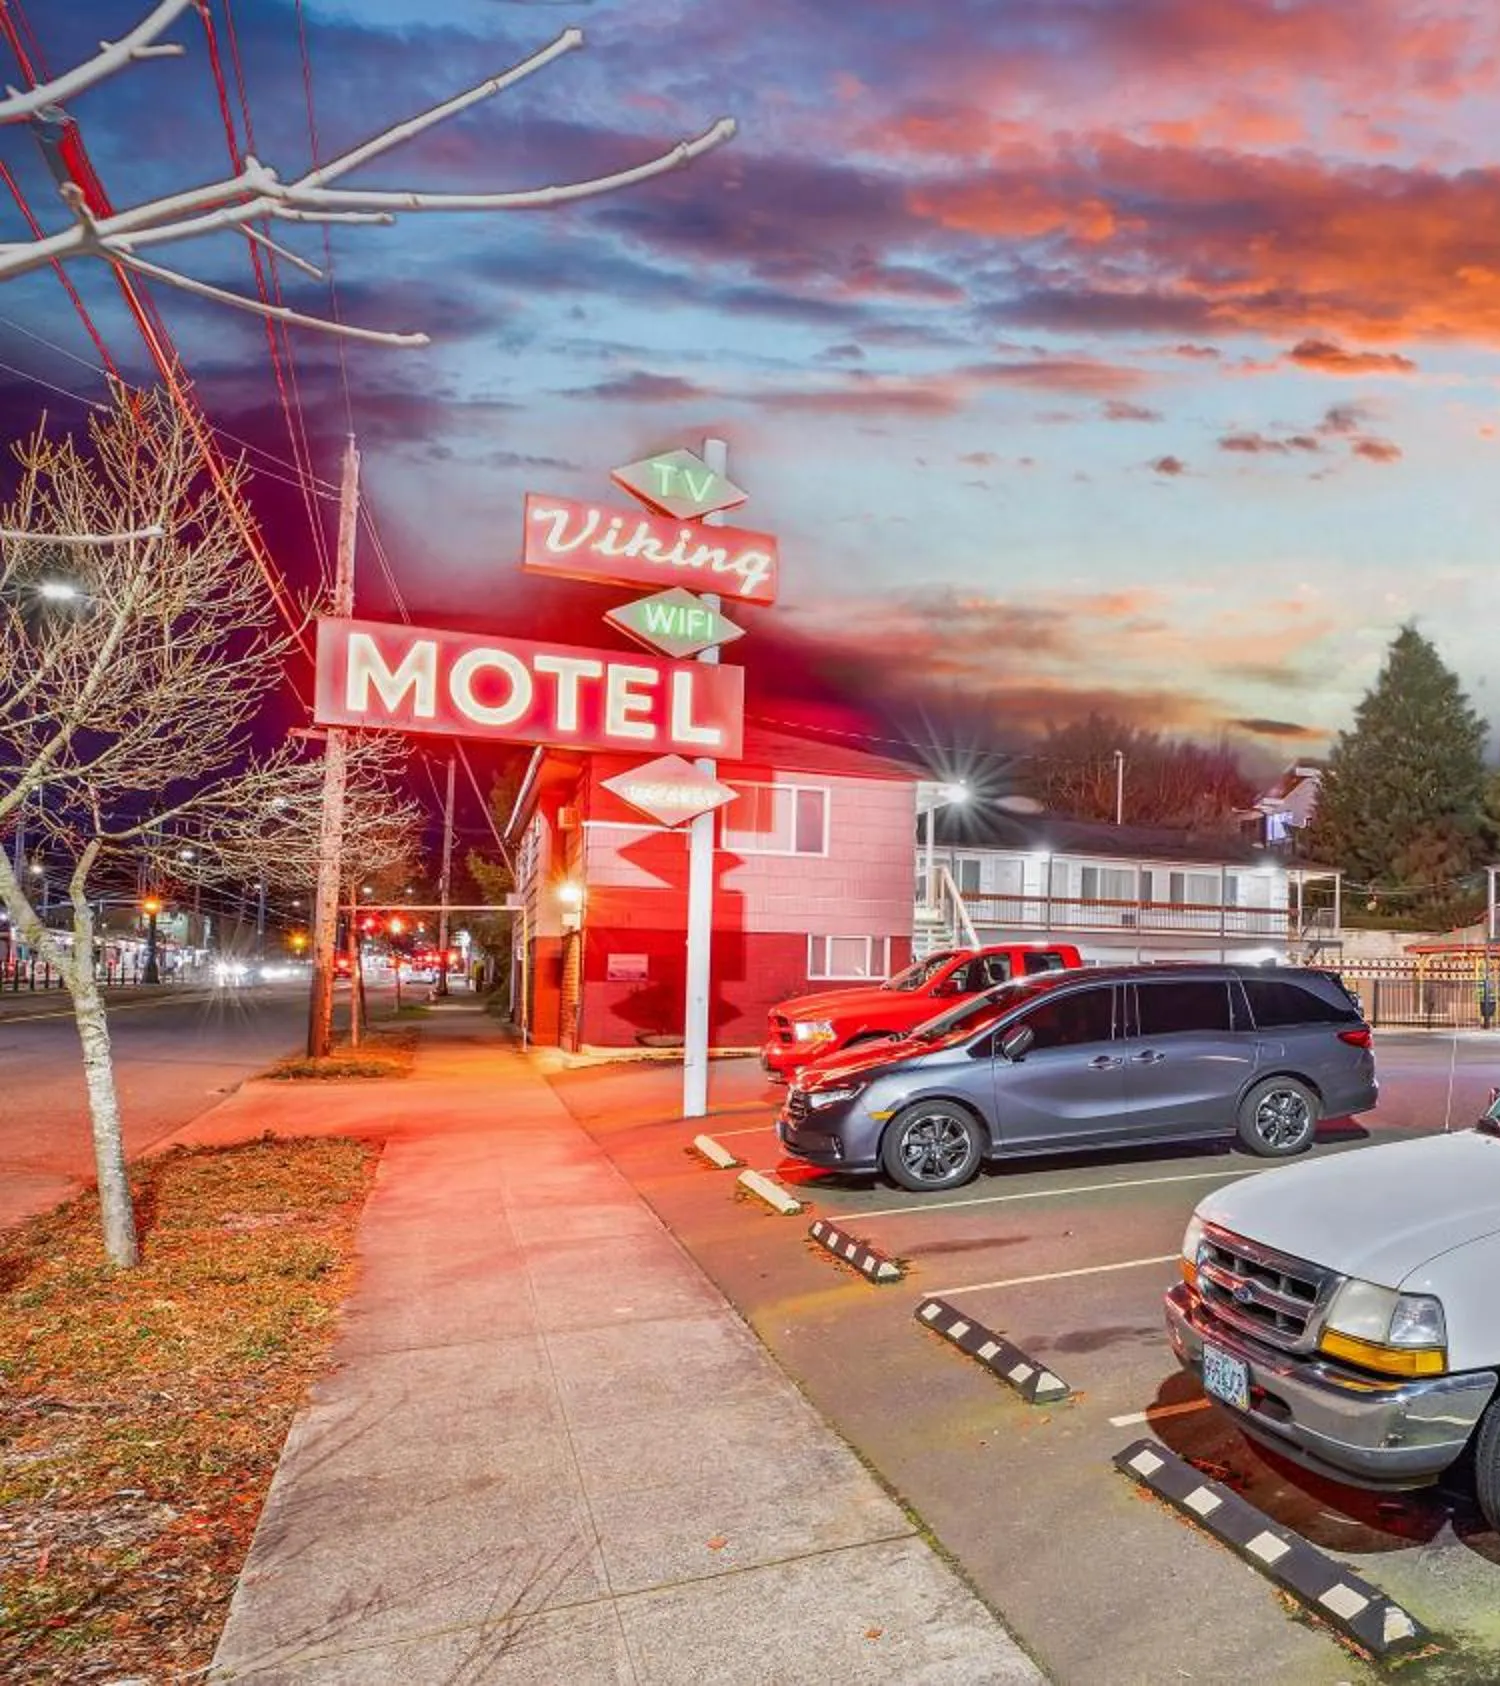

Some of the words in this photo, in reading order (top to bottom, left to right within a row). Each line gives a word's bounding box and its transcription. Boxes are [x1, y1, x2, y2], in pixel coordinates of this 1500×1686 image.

[651, 461, 714, 503] TV
[533, 506, 772, 594] Viking
[642, 602, 714, 641] WIFI
[345, 633, 723, 746] MOTEL
